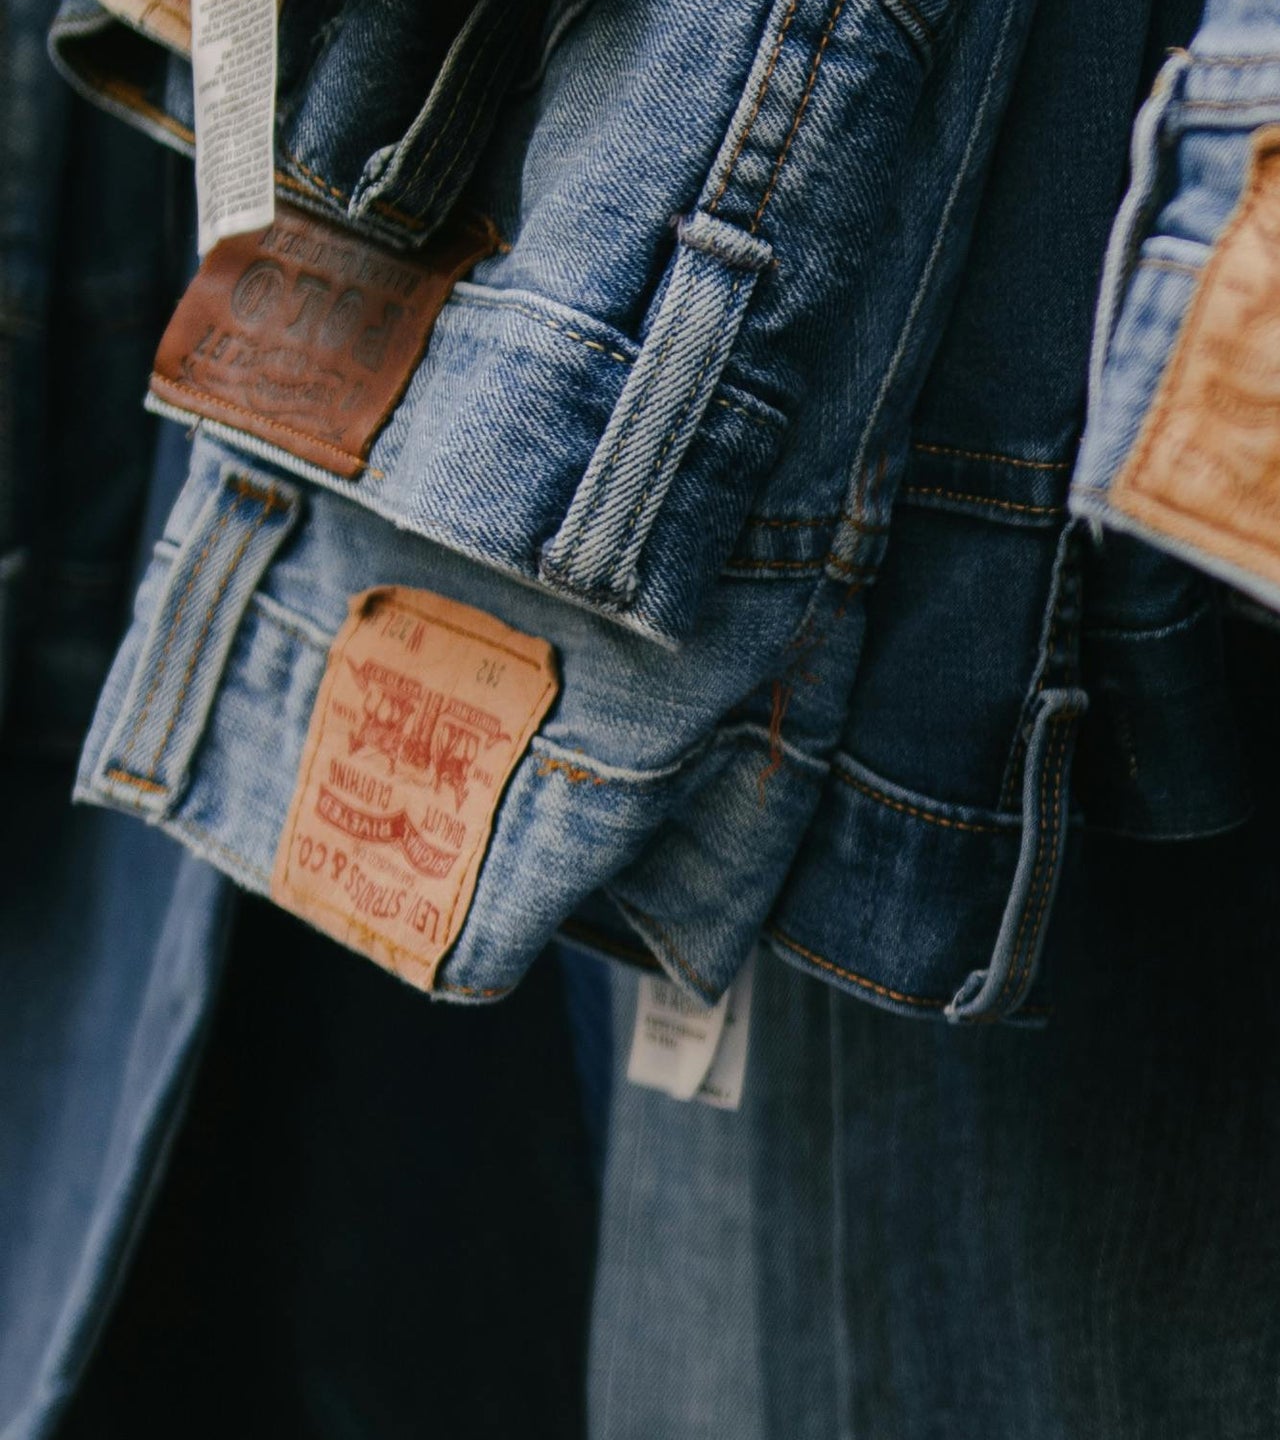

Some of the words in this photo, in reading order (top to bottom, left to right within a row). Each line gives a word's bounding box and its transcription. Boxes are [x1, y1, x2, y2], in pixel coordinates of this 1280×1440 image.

[231, 257, 404, 373] POLO
[296, 833, 327, 871] CO.
[331, 850, 347, 881] &
[344, 865, 407, 919] STRAUSS
